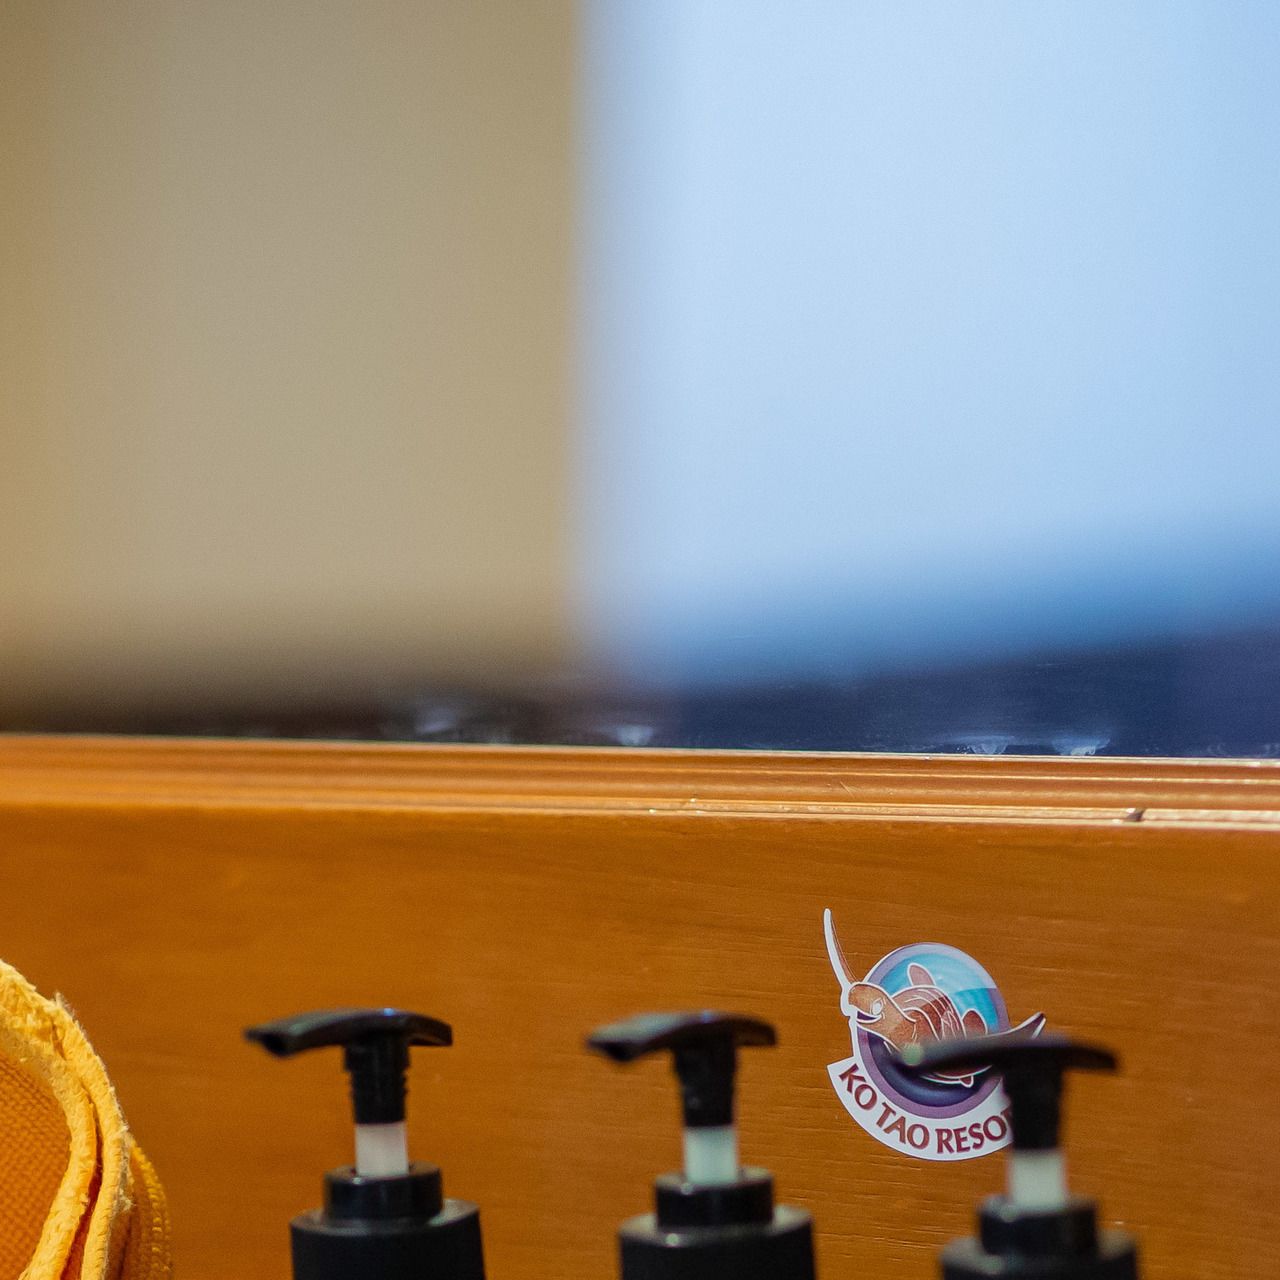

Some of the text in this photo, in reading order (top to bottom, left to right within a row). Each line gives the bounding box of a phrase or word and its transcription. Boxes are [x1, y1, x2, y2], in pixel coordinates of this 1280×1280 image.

[839, 1063, 1013, 1154] KO TAO RESO
